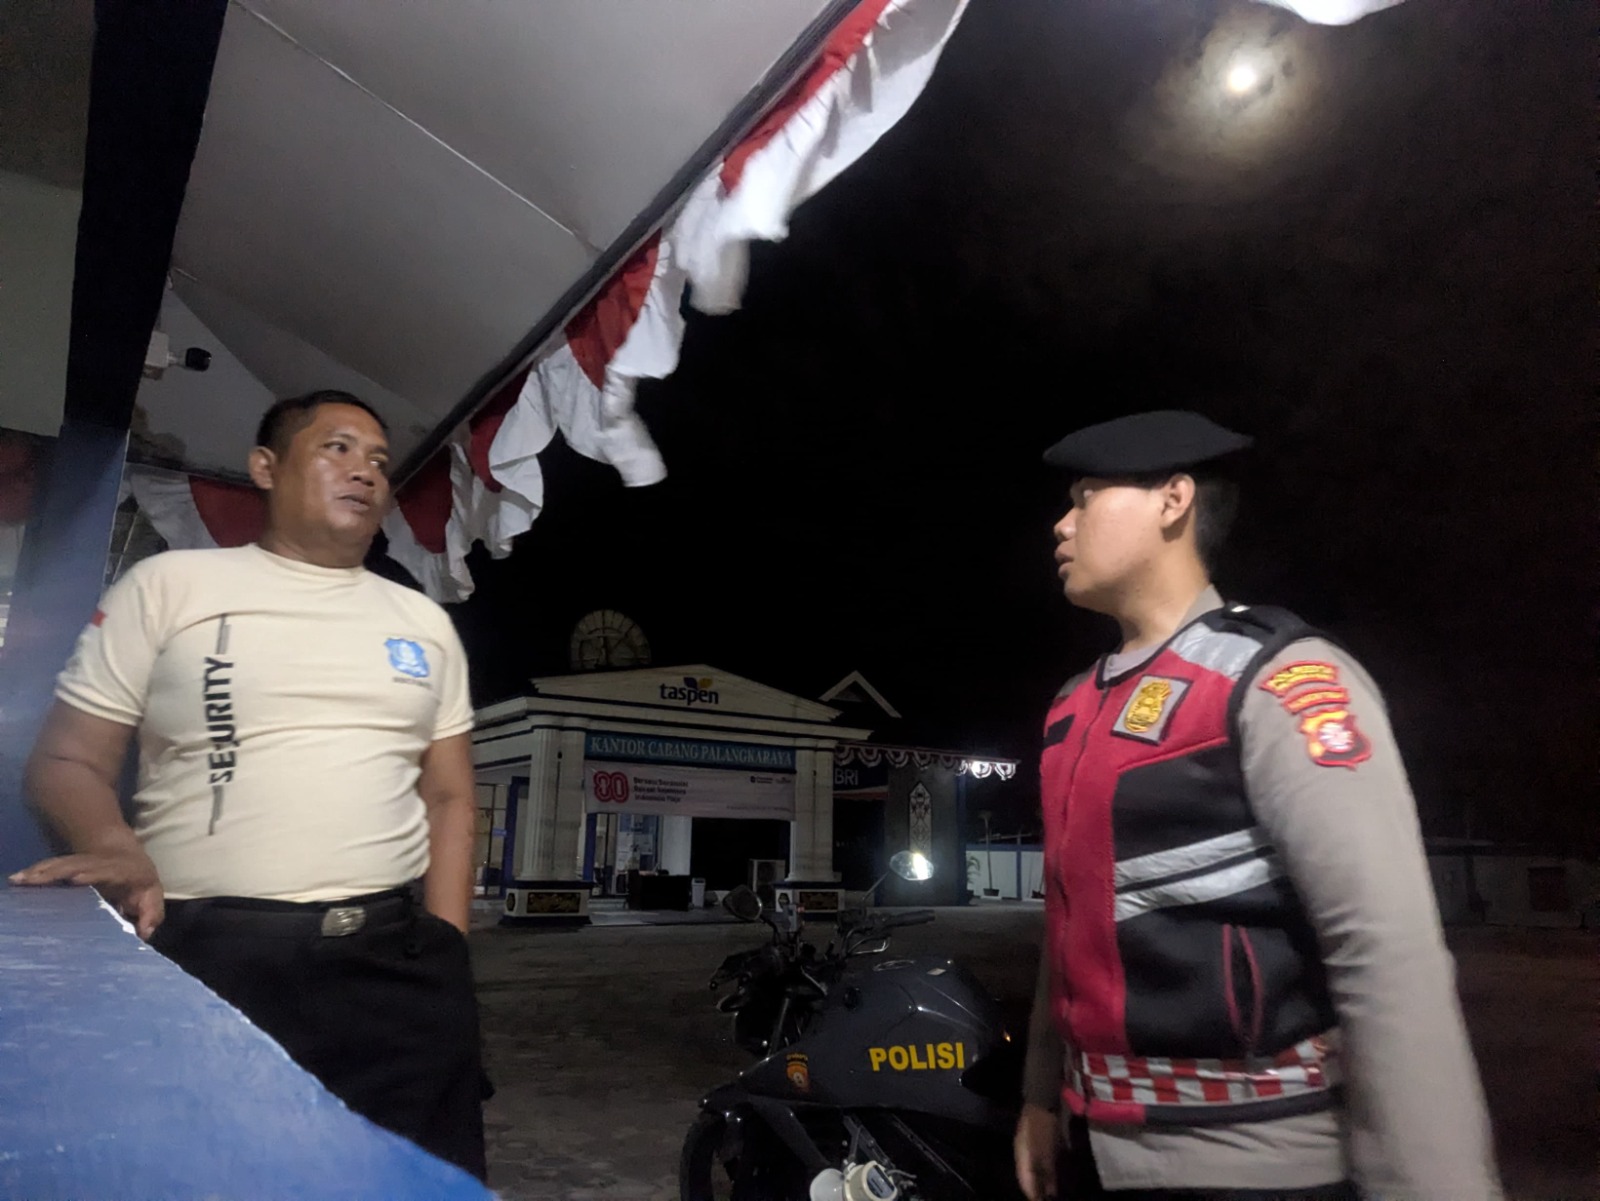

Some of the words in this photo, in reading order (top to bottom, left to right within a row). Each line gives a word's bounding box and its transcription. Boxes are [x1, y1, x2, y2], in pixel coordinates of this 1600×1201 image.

[660, 683, 718, 706] taspen
[590, 736, 645, 755] KANTOR
[648, 740, 699, 760] CABANG
[701, 744, 793, 765] PALANGKARAYA
[834, 768, 859, 786] BRI
[868, 1042, 965, 1071] POLISI
